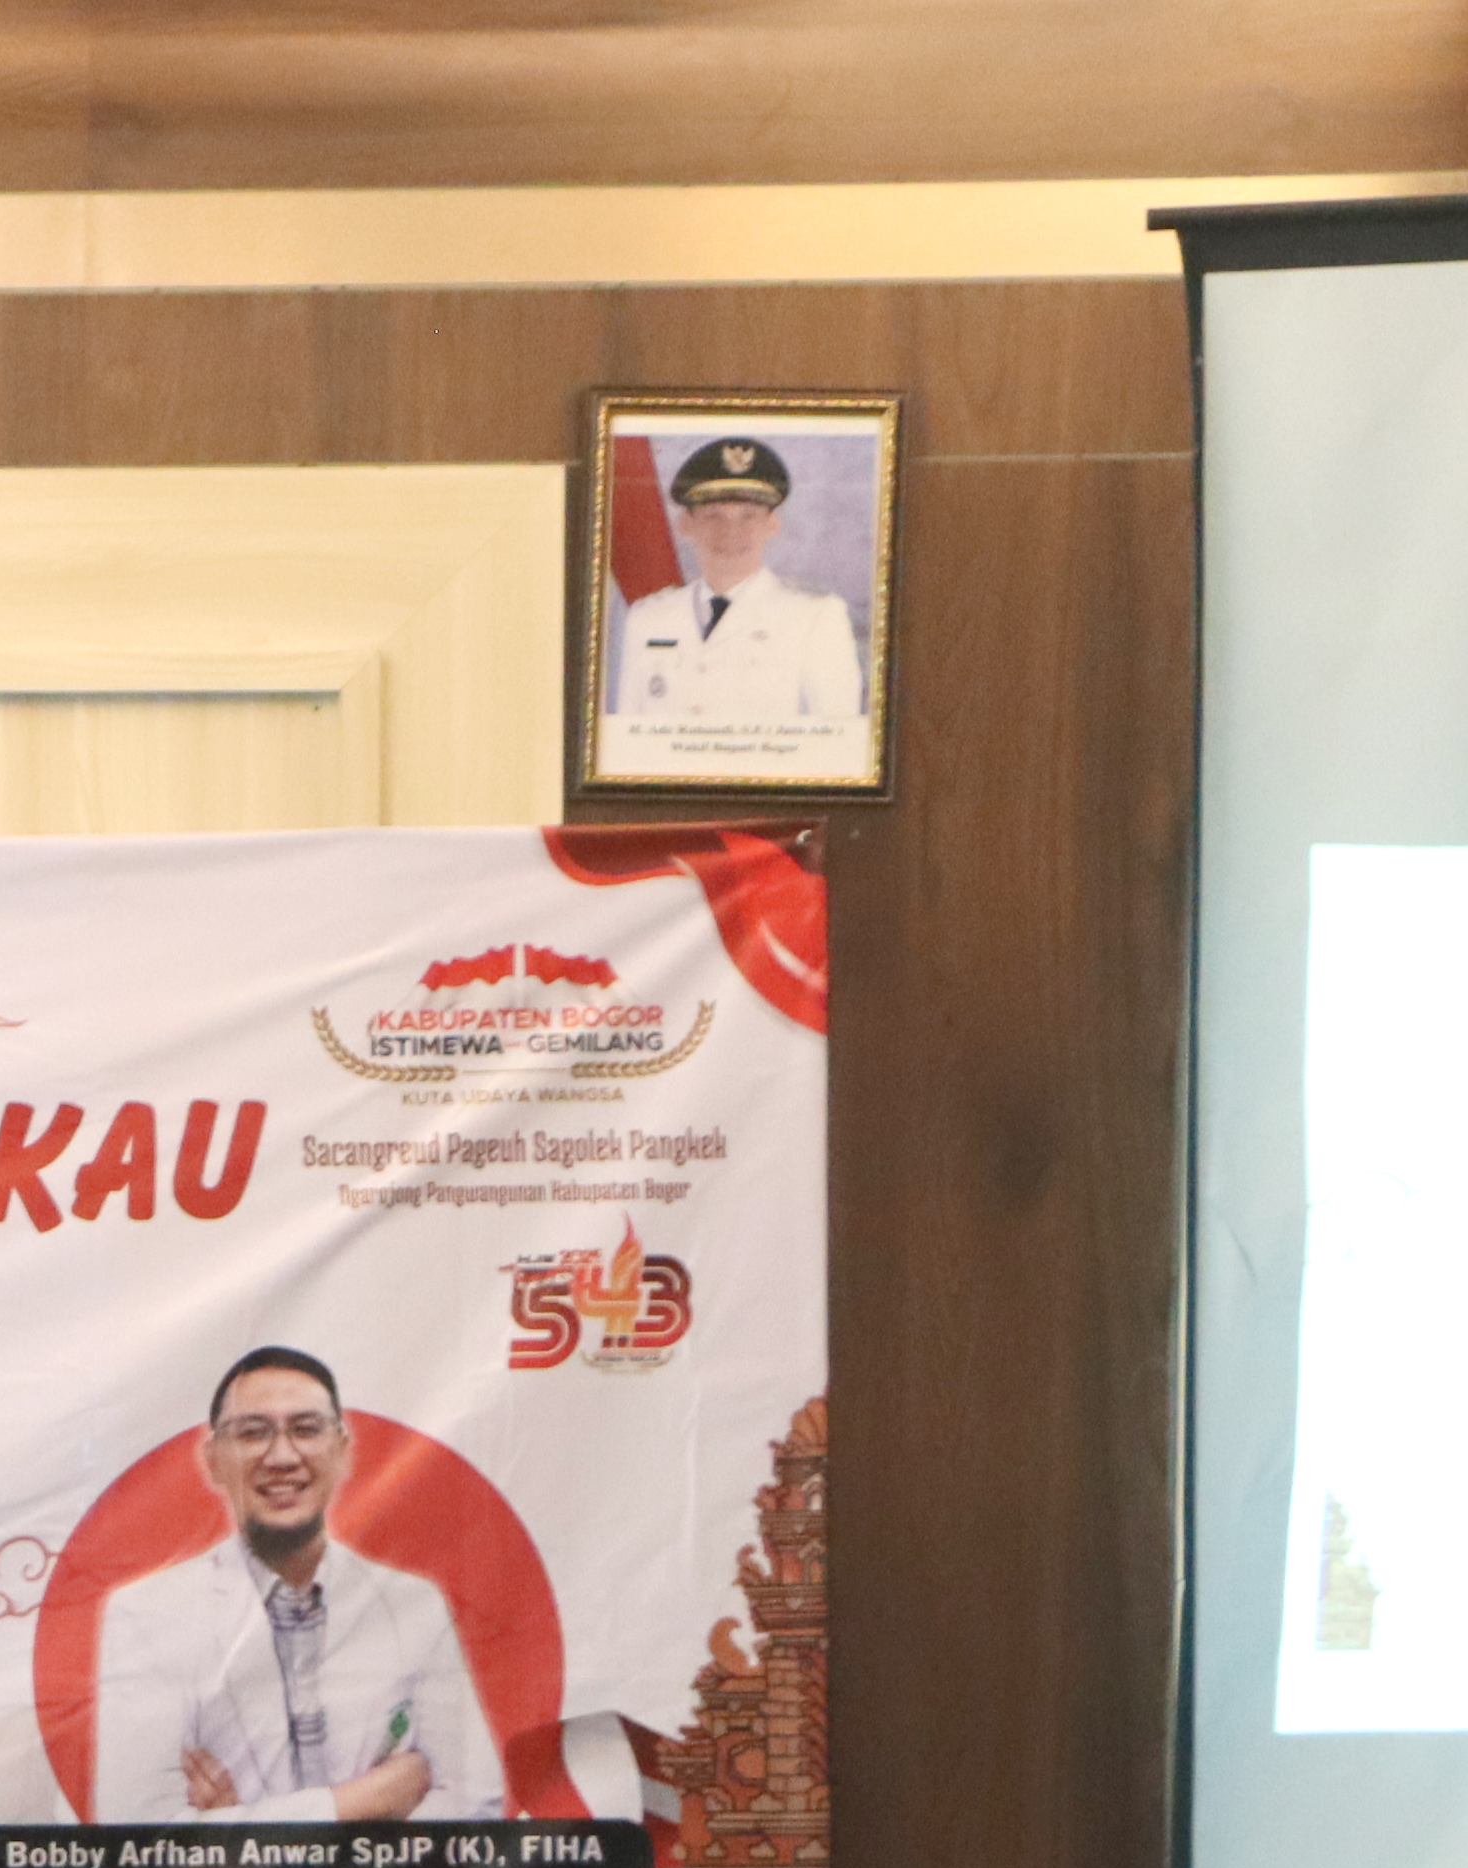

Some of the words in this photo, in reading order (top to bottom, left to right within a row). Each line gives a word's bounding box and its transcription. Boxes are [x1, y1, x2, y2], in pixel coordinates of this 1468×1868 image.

[376, 1005, 552, 1032] KABUPATEN
[561, 1004, 665, 1029] BOGOR
[370, 1033, 504, 1057] ISTIMEWA
[526, 1031, 665, 1054] GEMILANG
[402, 1090, 454, 1105] KUTA
[447, 1129, 527, 1169] Pageuh
[508, 1213, 693, 1370] 543
[118, 1839, 227, 1868] Arfhan
[240, 1838, 340, 1866] Anwar
[445, 1835, 507, 1868] (K),
[520, 1835, 604, 1864] FIHA
